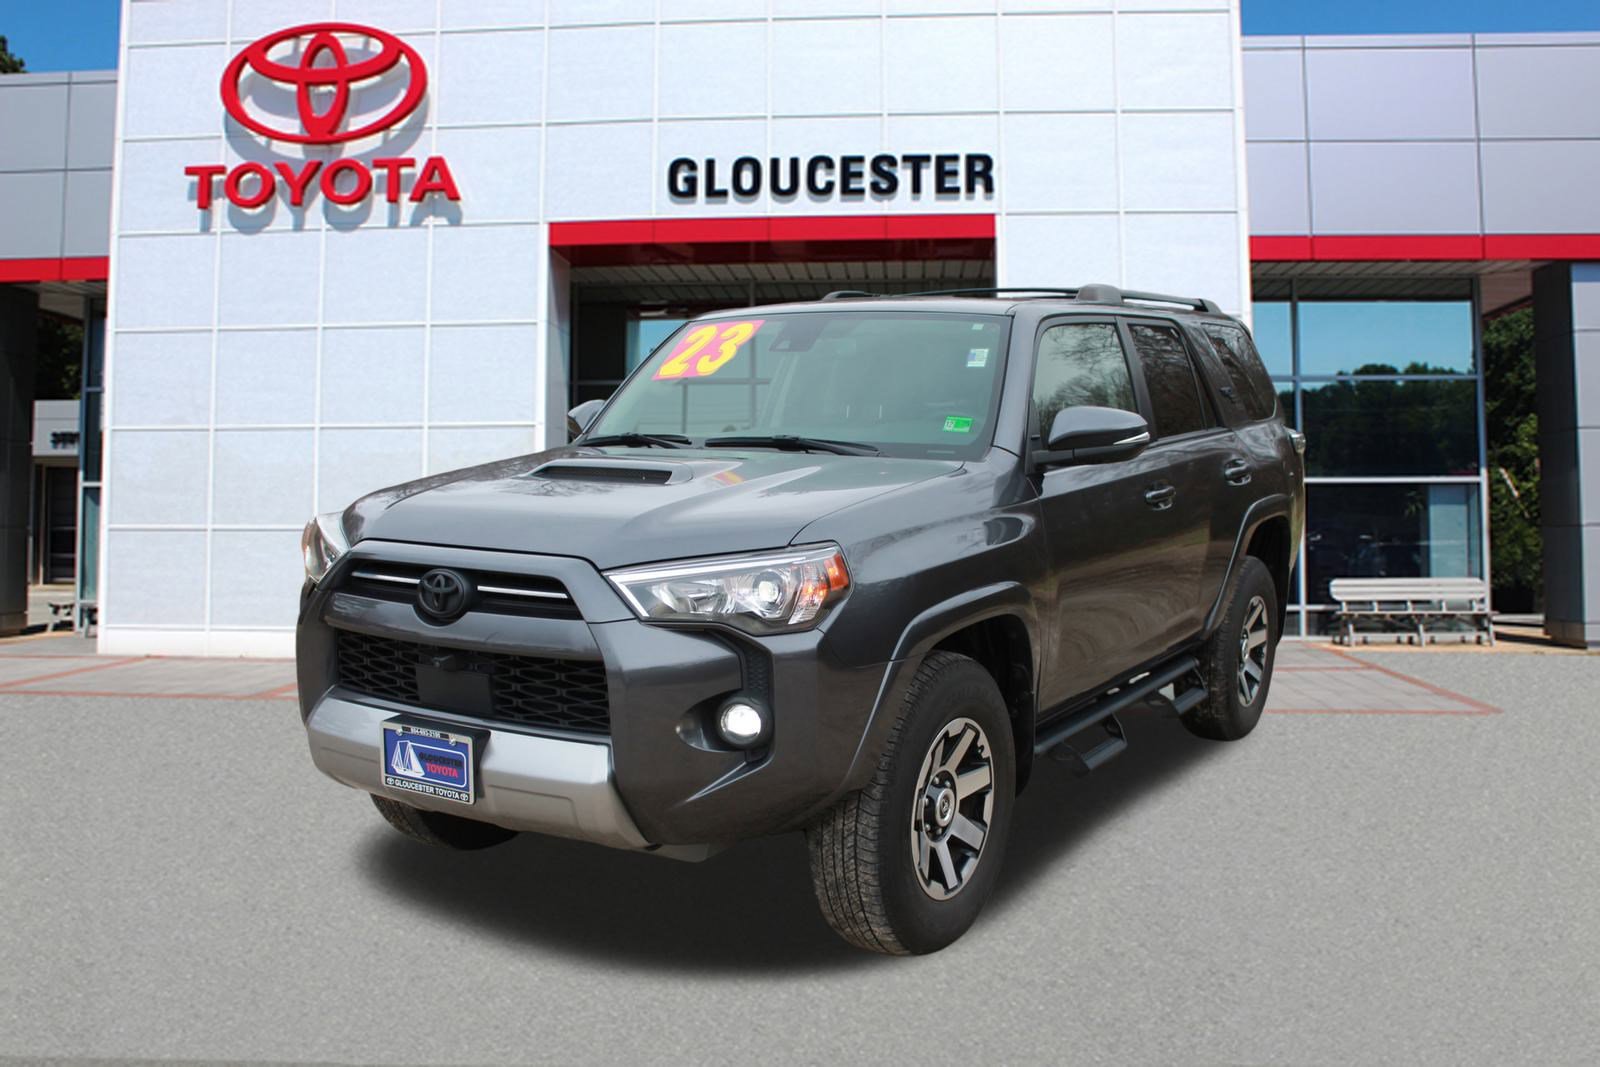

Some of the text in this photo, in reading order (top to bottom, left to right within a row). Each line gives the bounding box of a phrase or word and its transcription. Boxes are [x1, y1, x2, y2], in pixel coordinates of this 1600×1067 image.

[185, 156, 461, 210] TOYOTA
[667, 154, 994, 198] GLOUCESTER
[659, 322, 754, 376] 23
[419, 752, 463, 768] GLOUCESTER
[426, 763, 458, 778] TOYOTA
[394, 780, 459, 800] GLOUCESTER TOYOTA
